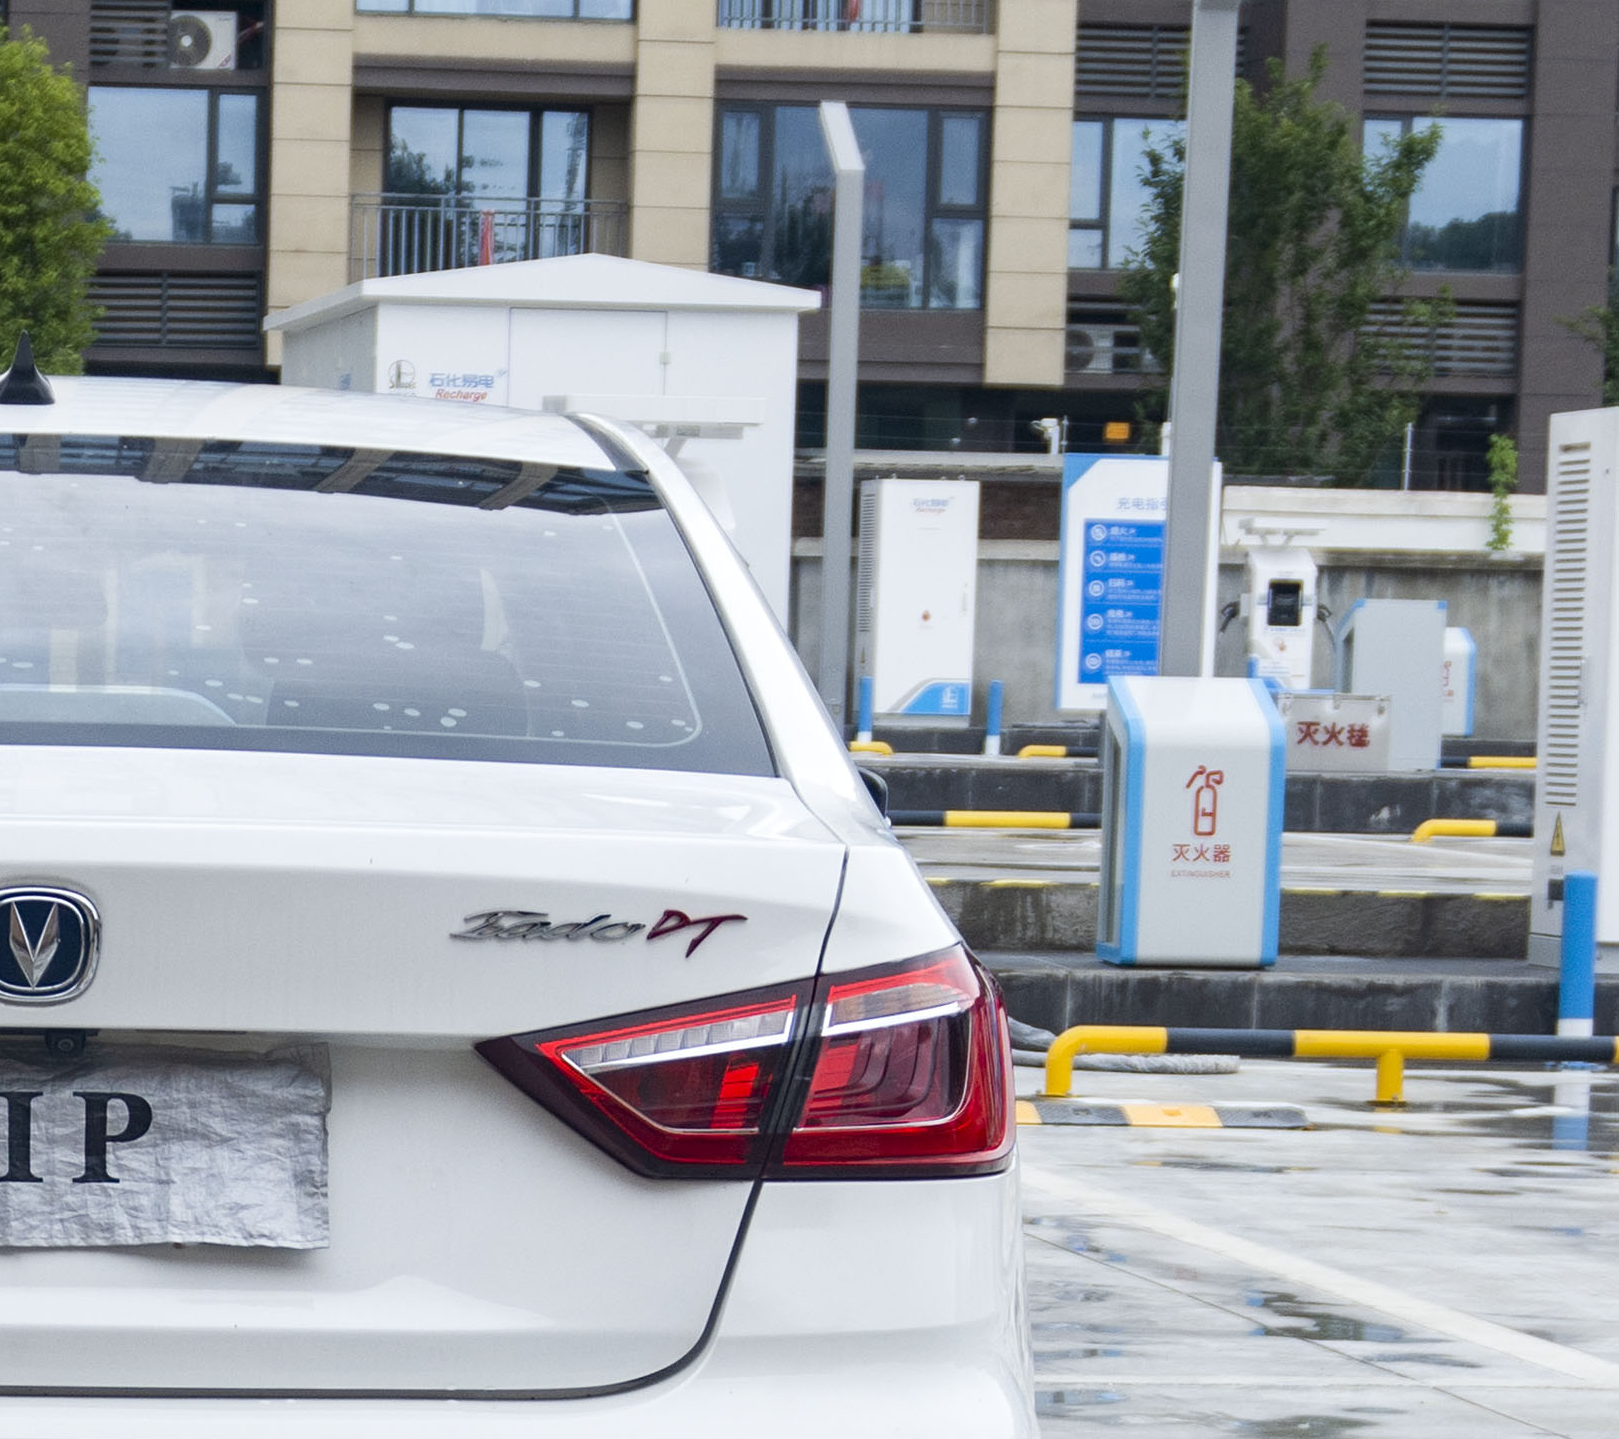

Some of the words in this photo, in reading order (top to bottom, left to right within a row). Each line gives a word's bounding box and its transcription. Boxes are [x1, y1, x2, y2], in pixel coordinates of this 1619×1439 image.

[429, 373, 494, 389] 石化易电
[436, 388, 487, 402] Recharge
[1172, 843, 1232, 863] 灭火器
[645, 909, 749, 959] DT
